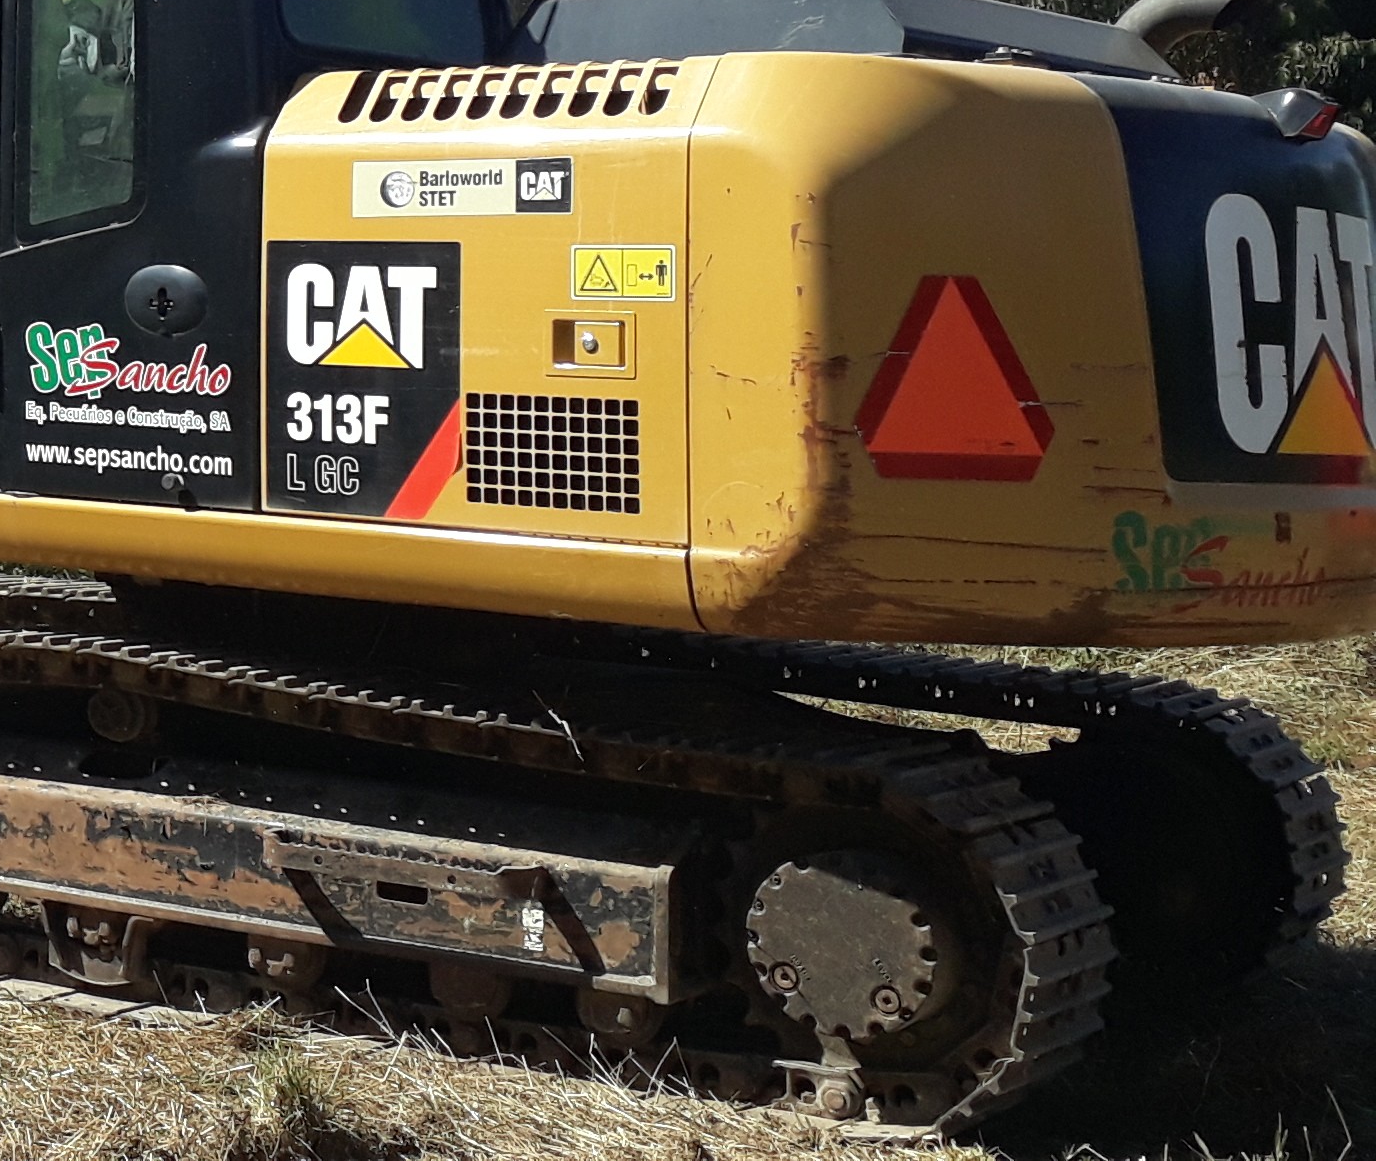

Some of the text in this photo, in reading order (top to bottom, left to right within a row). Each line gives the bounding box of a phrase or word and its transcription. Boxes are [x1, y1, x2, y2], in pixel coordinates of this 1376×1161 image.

[419, 169, 503, 187] Barloworld
[520, 171, 564, 201] CAT
[419, 190, 456, 207] STET
[287, 263, 437, 369] CAT
[1205, 193, 1376, 454] CAT
[65, 337, 232, 396] Sancho
[25, 400, 232, 433] Eq. Pecuários e Construção, SA
[286, 392, 390, 444] 313F
[25, 443, 233, 476] www.sepsancho.com
[287, 453, 360, 496] L GC
